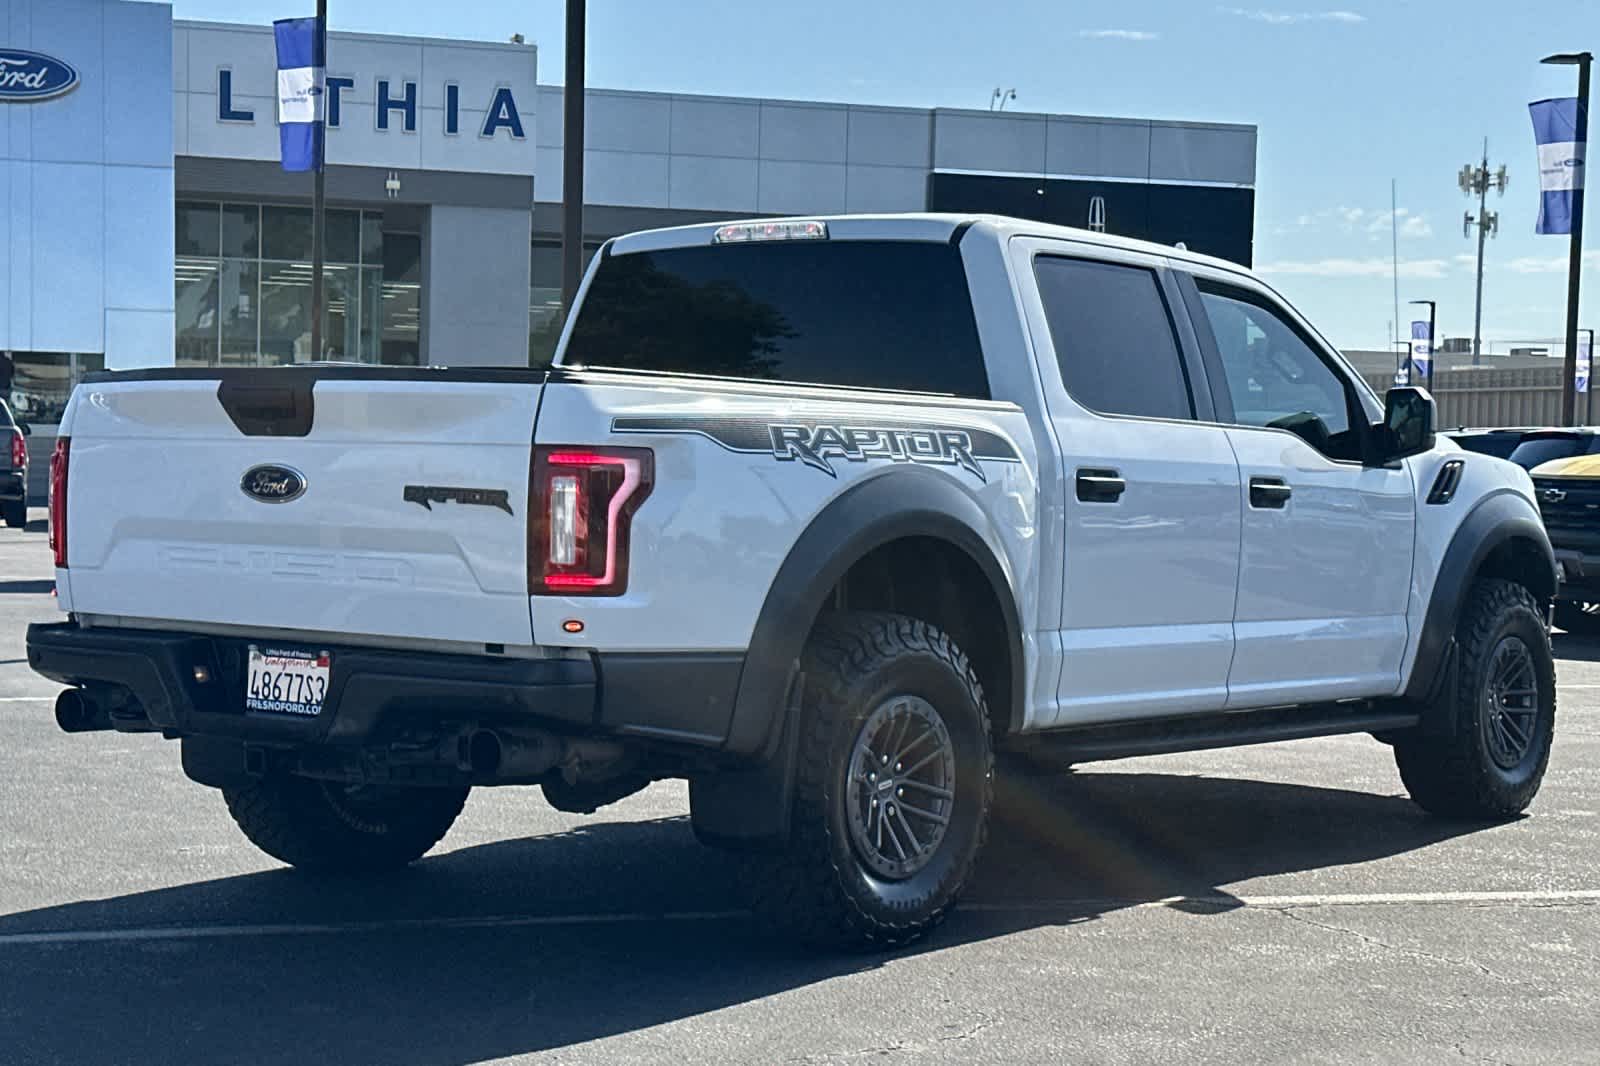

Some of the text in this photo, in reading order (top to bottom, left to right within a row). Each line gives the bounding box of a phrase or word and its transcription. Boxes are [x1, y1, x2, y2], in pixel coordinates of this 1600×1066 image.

[218, 69, 526, 138] LTHIA
[768, 423, 986, 484] RAPTOR
[252, 470, 289, 495] Ford
[250, 669, 326, 705] 48677S3
